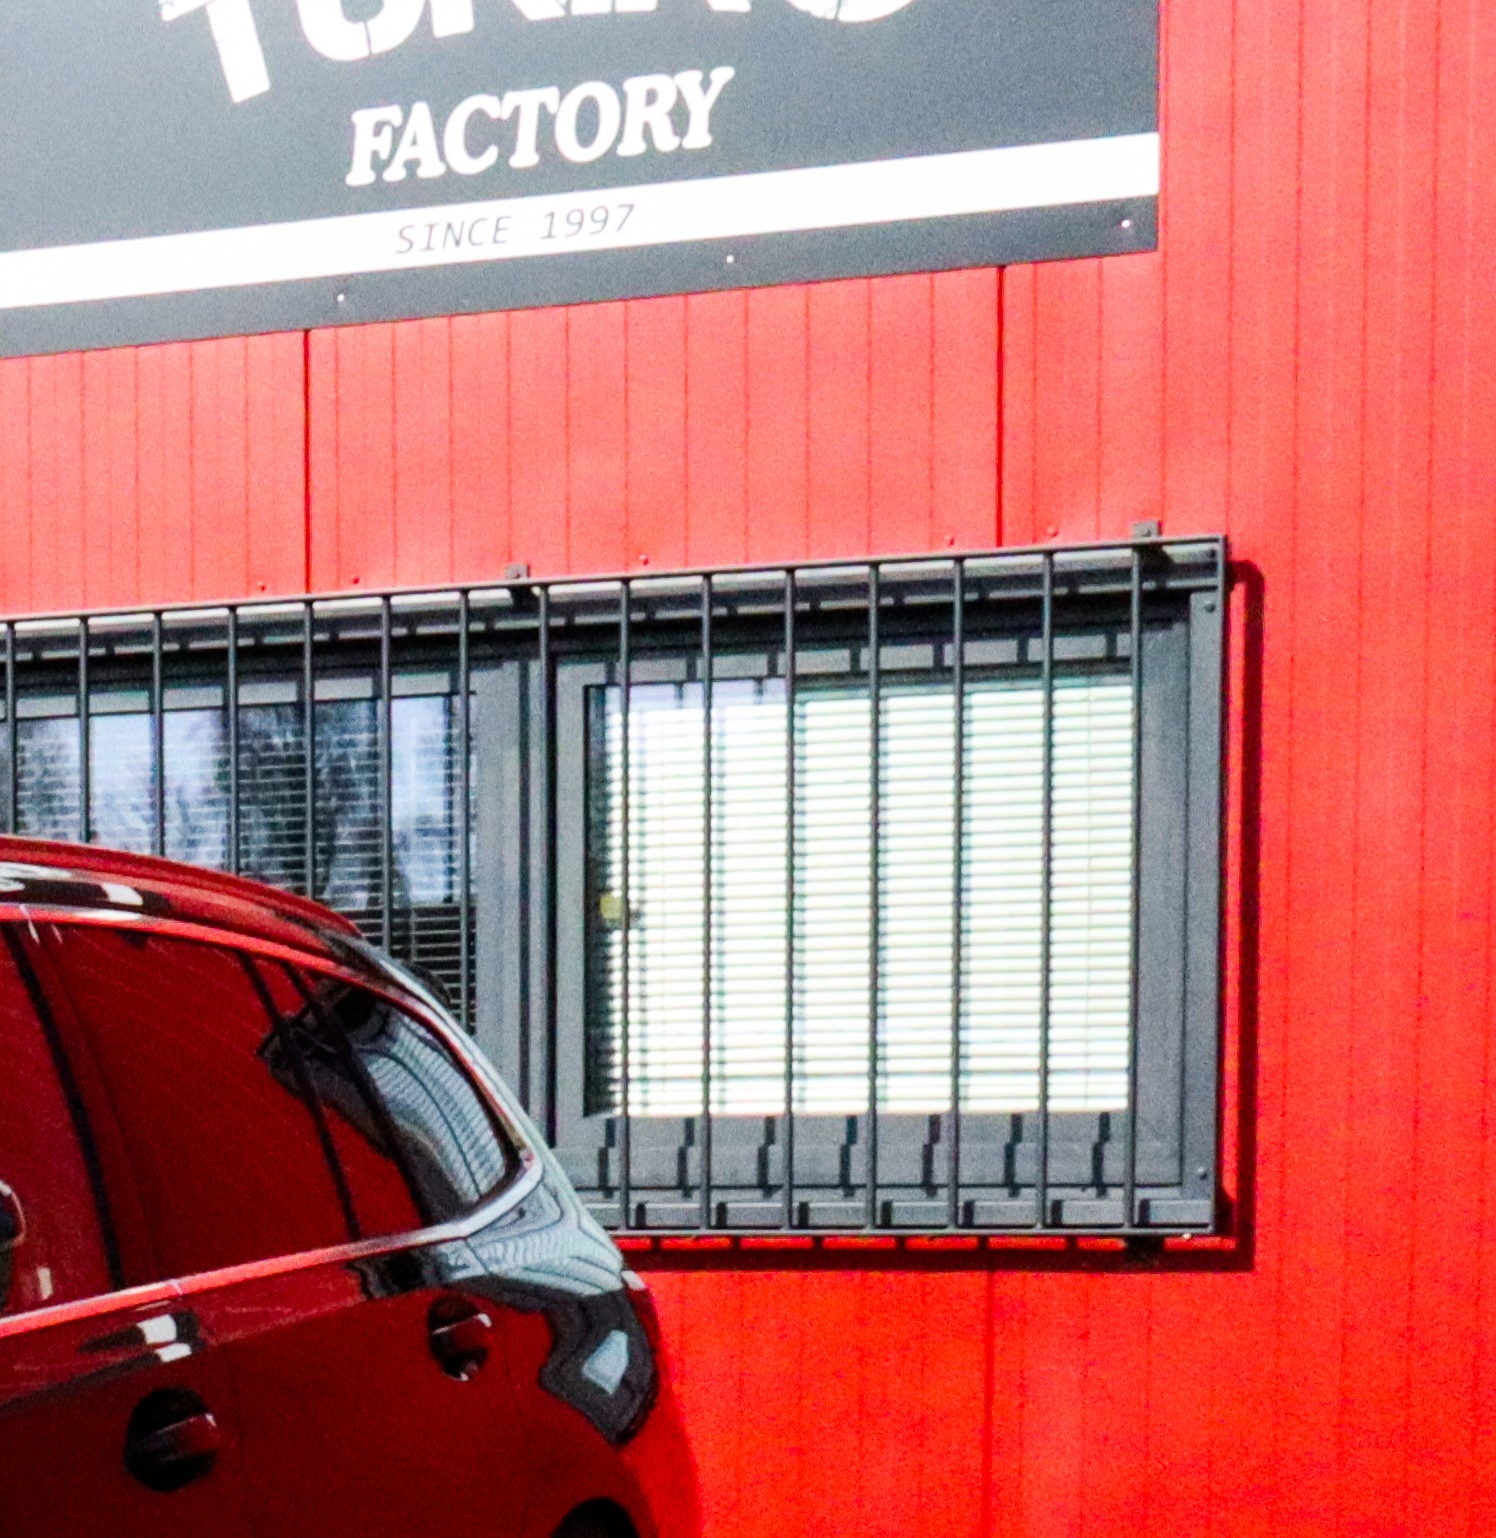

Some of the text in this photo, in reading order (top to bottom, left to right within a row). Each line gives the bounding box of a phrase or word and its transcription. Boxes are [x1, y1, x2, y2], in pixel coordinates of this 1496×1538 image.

[345, 65, 736, 187] FACTORY
[394, 203, 636, 254] SINCE 1997
